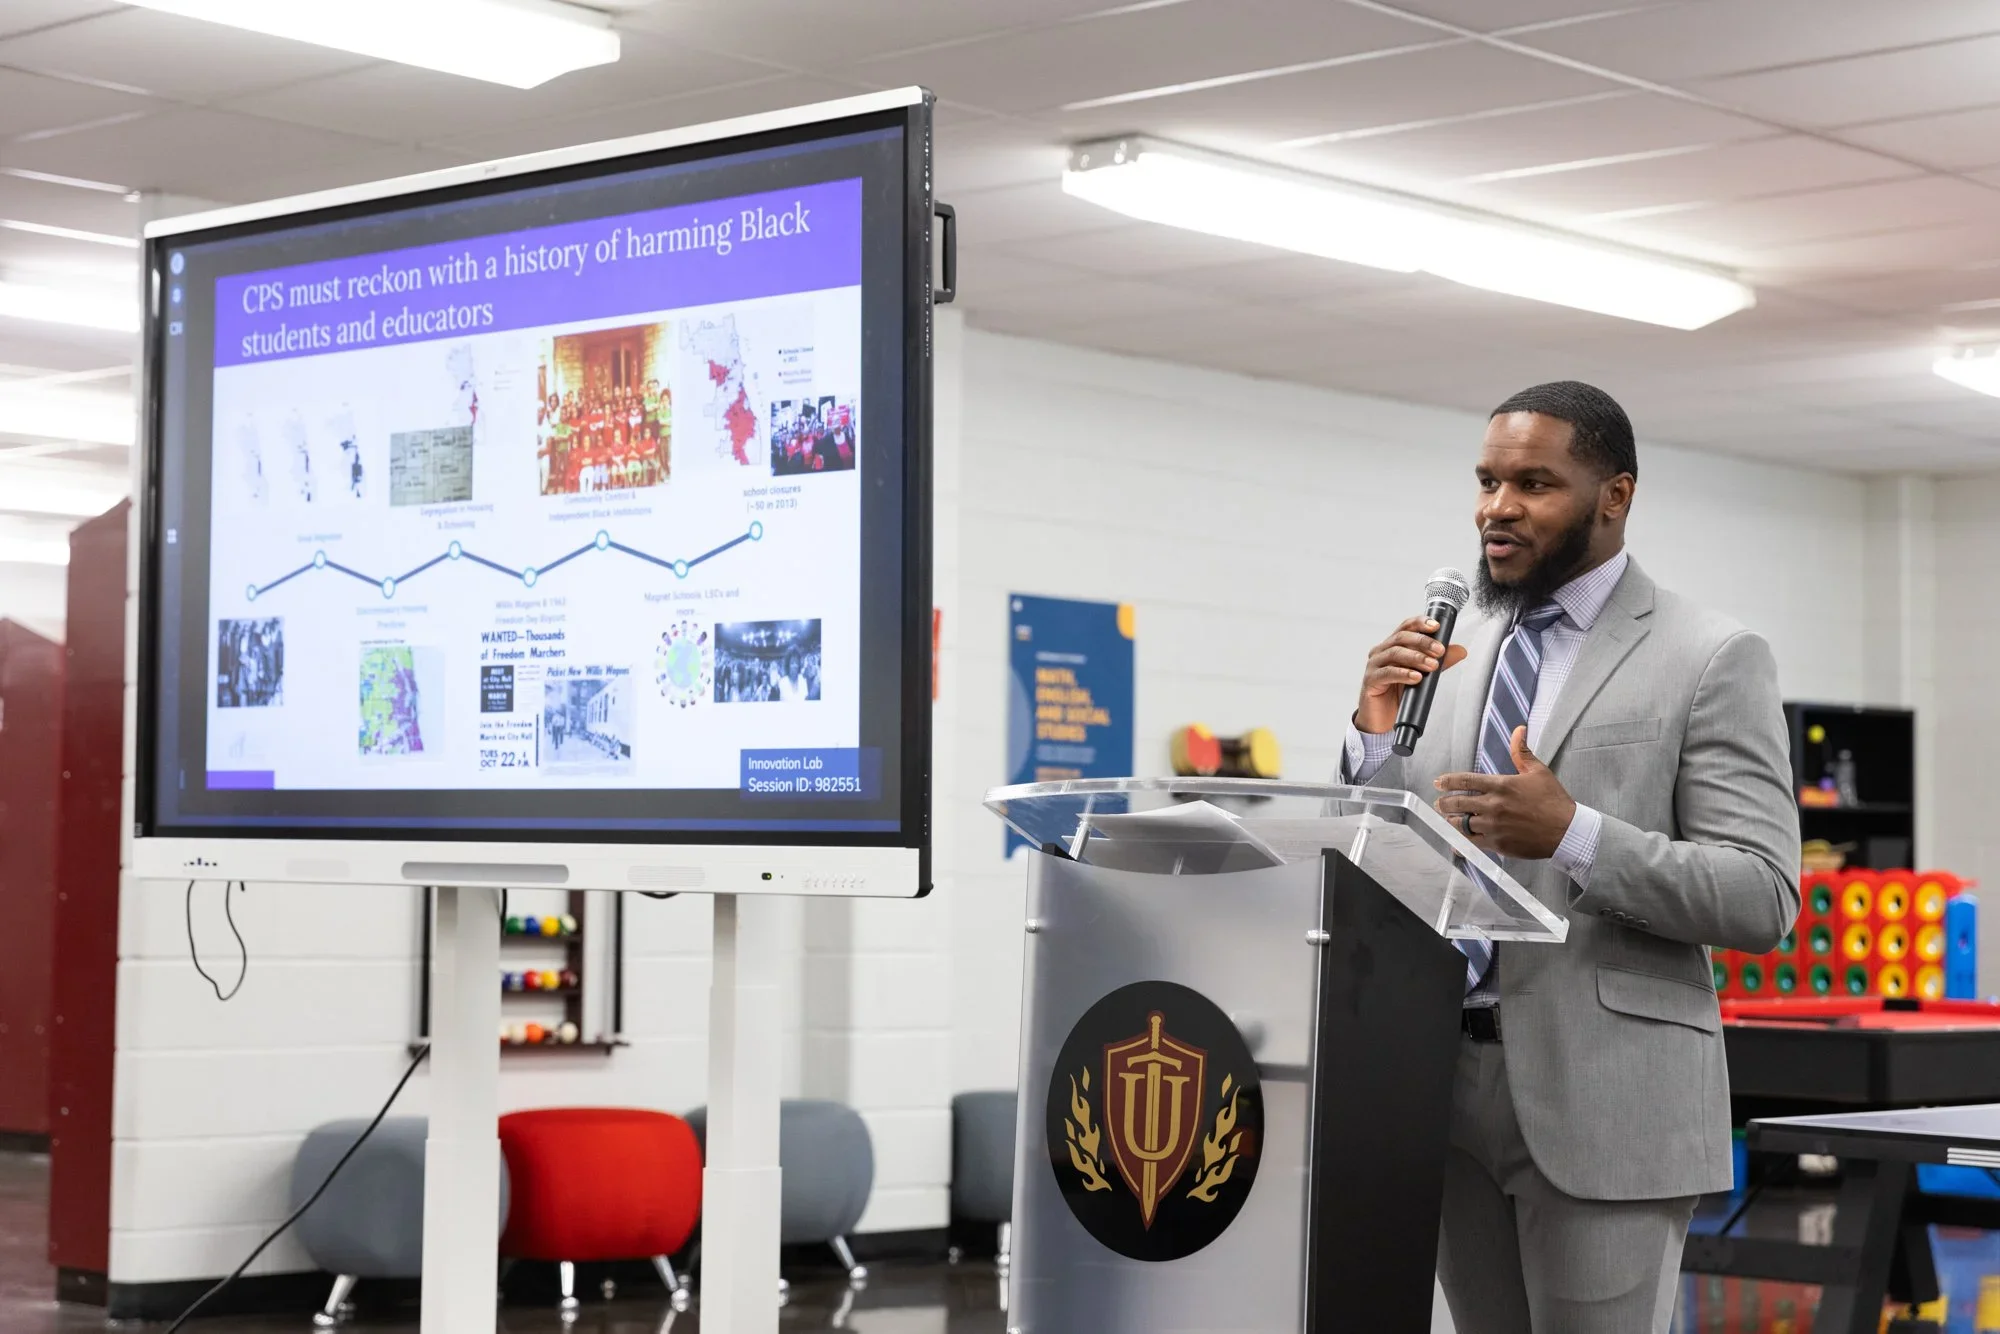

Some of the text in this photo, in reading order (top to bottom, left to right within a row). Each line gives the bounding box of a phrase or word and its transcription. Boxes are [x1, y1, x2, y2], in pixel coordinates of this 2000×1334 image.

[243, 201, 810, 314] CPS must reckon with a history of harming Black
[242, 302, 494, 357] students and educators
[743, 484, 801, 497] school closures
[767, 500, 774, 510] in
[775, 498, 798, 510] 2013)
[480, 645, 566, 661] of Freedom Marchers
[480, 759, 497, 768] OCT
[501, 751, 516, 767] 22
[748, 756, 823, 770] Innovation Lab
[748, 777, 861, 792] Session ID: 982551
